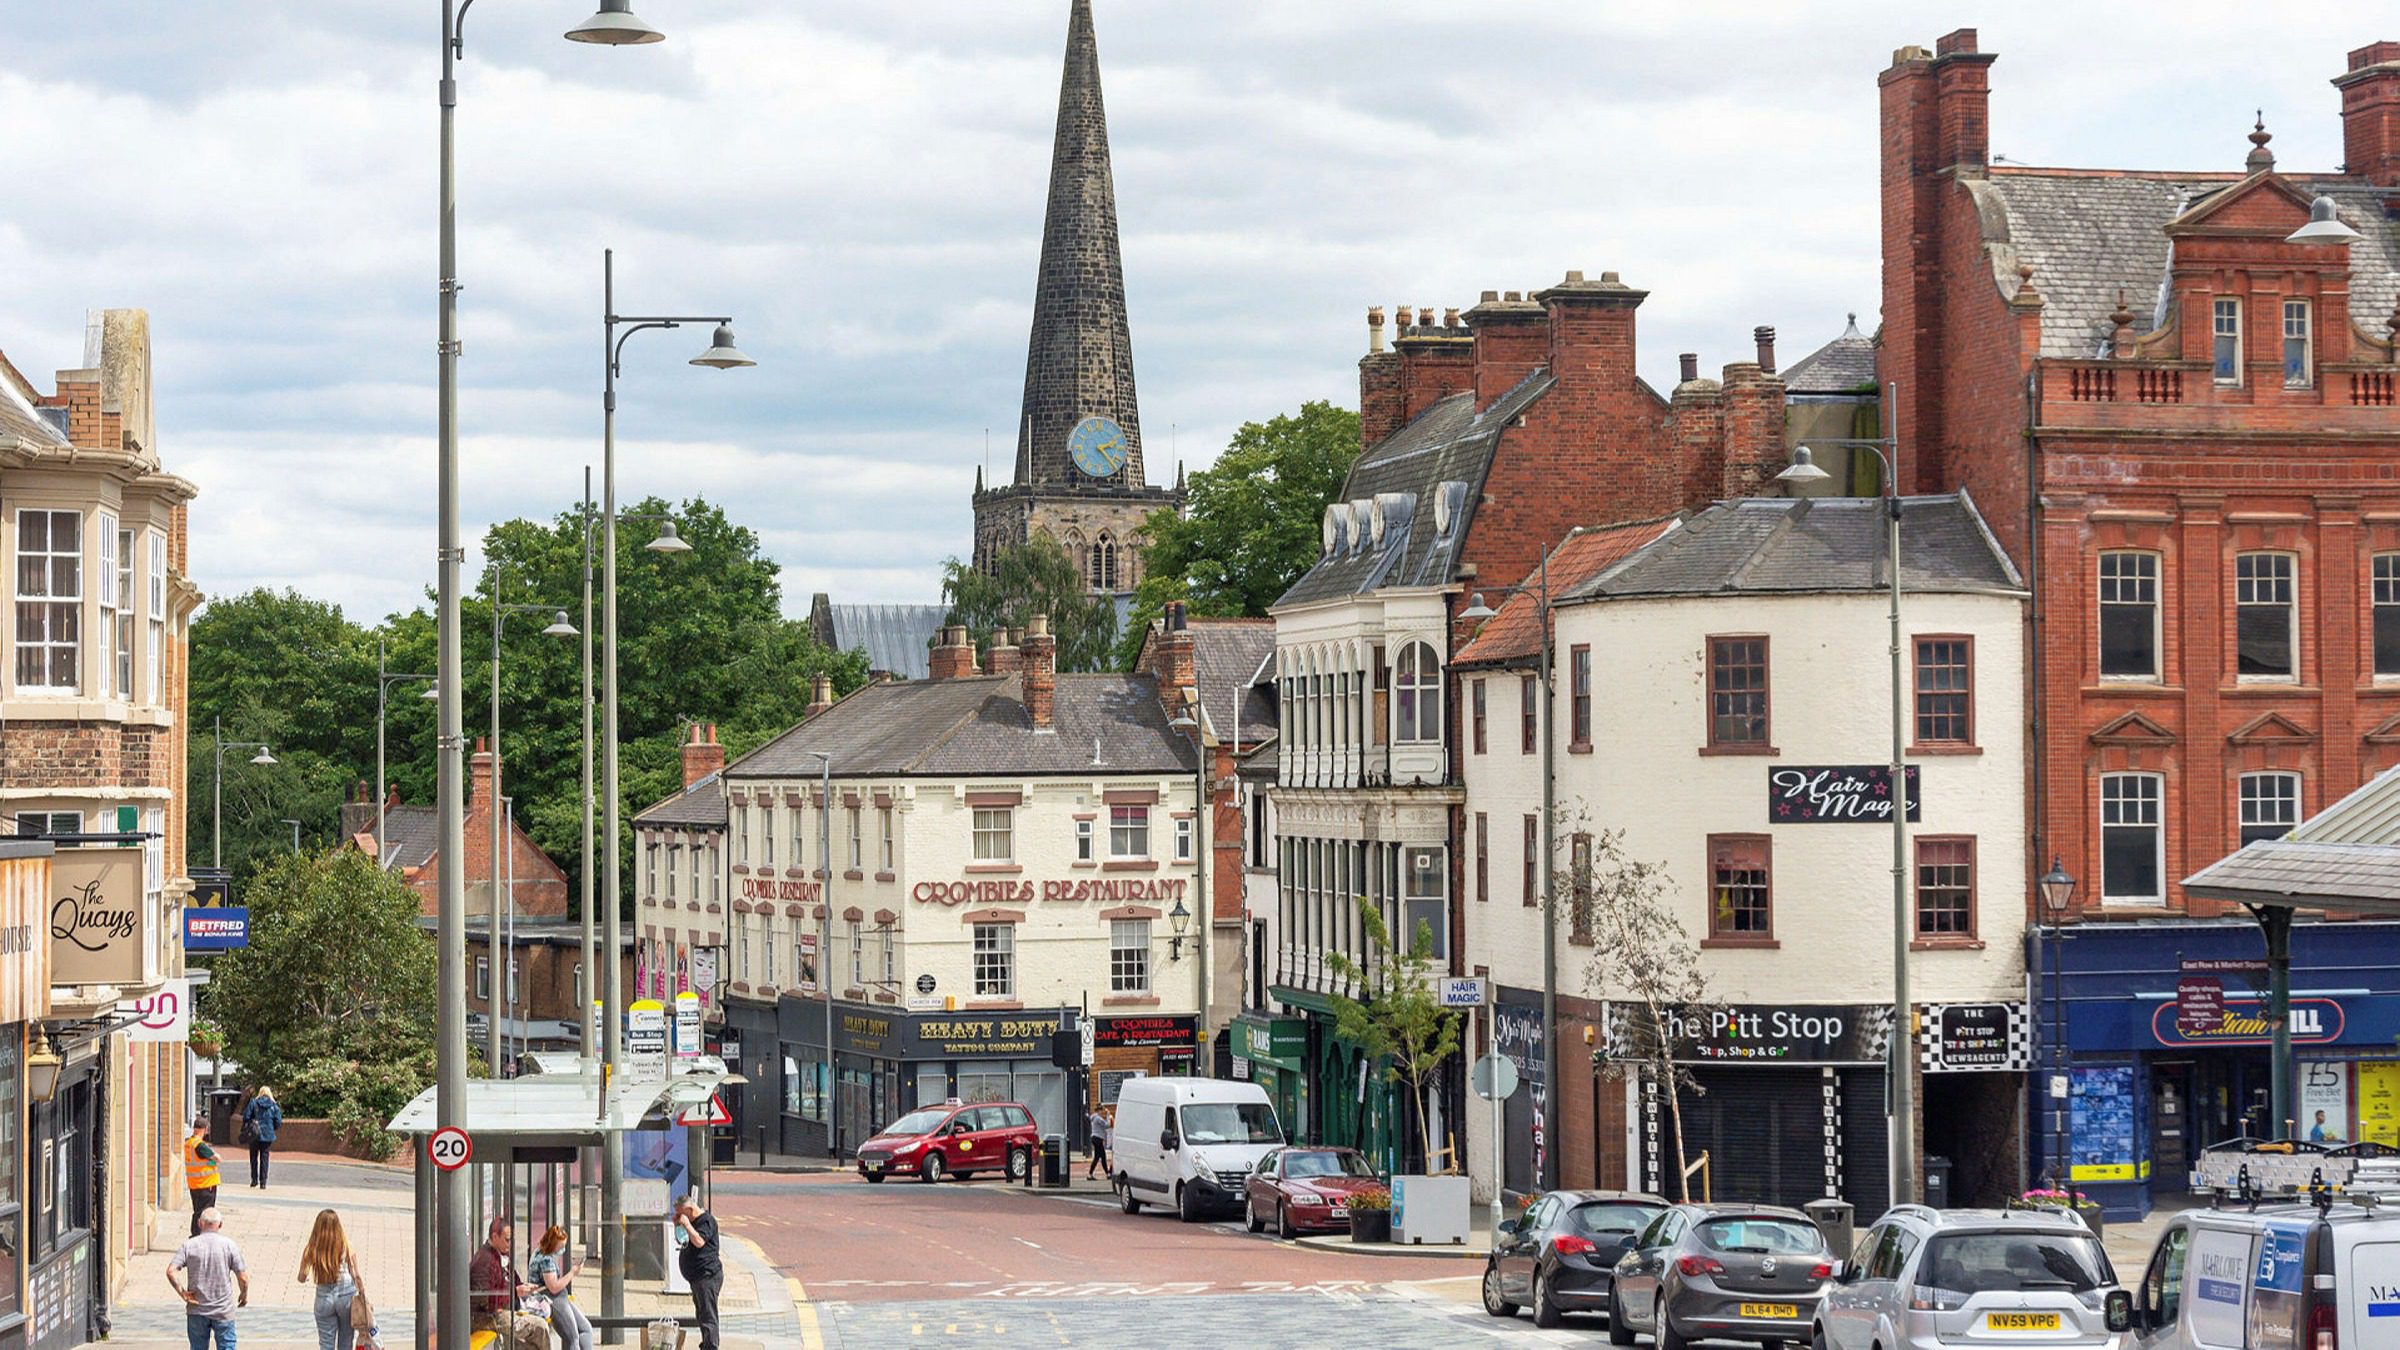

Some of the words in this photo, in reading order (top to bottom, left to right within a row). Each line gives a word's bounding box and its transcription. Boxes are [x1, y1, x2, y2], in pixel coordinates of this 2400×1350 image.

[1773, 770, 1869, 798] Hair
[1809, 794, 1918, 818] Magc
[73, 880, 104, 910] The
[743, 879, 777, 901] CROMBIES
[913, 880, 1035, 907] CROMBIES
[1043, 879, 1187, 901] RESTAURANT
[51, 897, 137, 952] Quays
[191, 920, 244, 931] BETFRED
[1452, 983, 1477, 992] HAIR
[1447, 993, 1480, 1003] MAGIC
[1964, 1009, 1985, 1018] THE
[1111, 1018, 1174, 1030] CROMBIES
[1712, 1008, 1763, 1038] Pitt
[1771, 1011, 1842, 1045] Stop
[2289, 1009, 2323, 1033] ILL
[646, 1031, 663, 1039] Stop
[920, 1021, 994, 1039] HEAVY
[1000, 1020, 1059, 1038] DUTY
[1131, 1029, 1190, 1040] RESTAURANT
[1976, 1027, 1996, 1036] STOP
[944, 1043, 985, 1052] TATTOO
[987, 1042, 1036, 1051] COMPANY
[1729, 1046, 1756, 1057] Shop
[1757, 1047, 1767, 1056] &
[1946, 1053, 2007, 1063] NEWSAGENTS
[2307, 1062, 2339, 1087] £5
[435, 1140, 466, 1157] 20
[2202, 1252, 2243, 1281] MARLOWE
[1745, 1304, 1771, 1314] DL64
[1993, 1313, 2026, 1327] NV59
[2031, 1313, 2055, 1327] VPG
